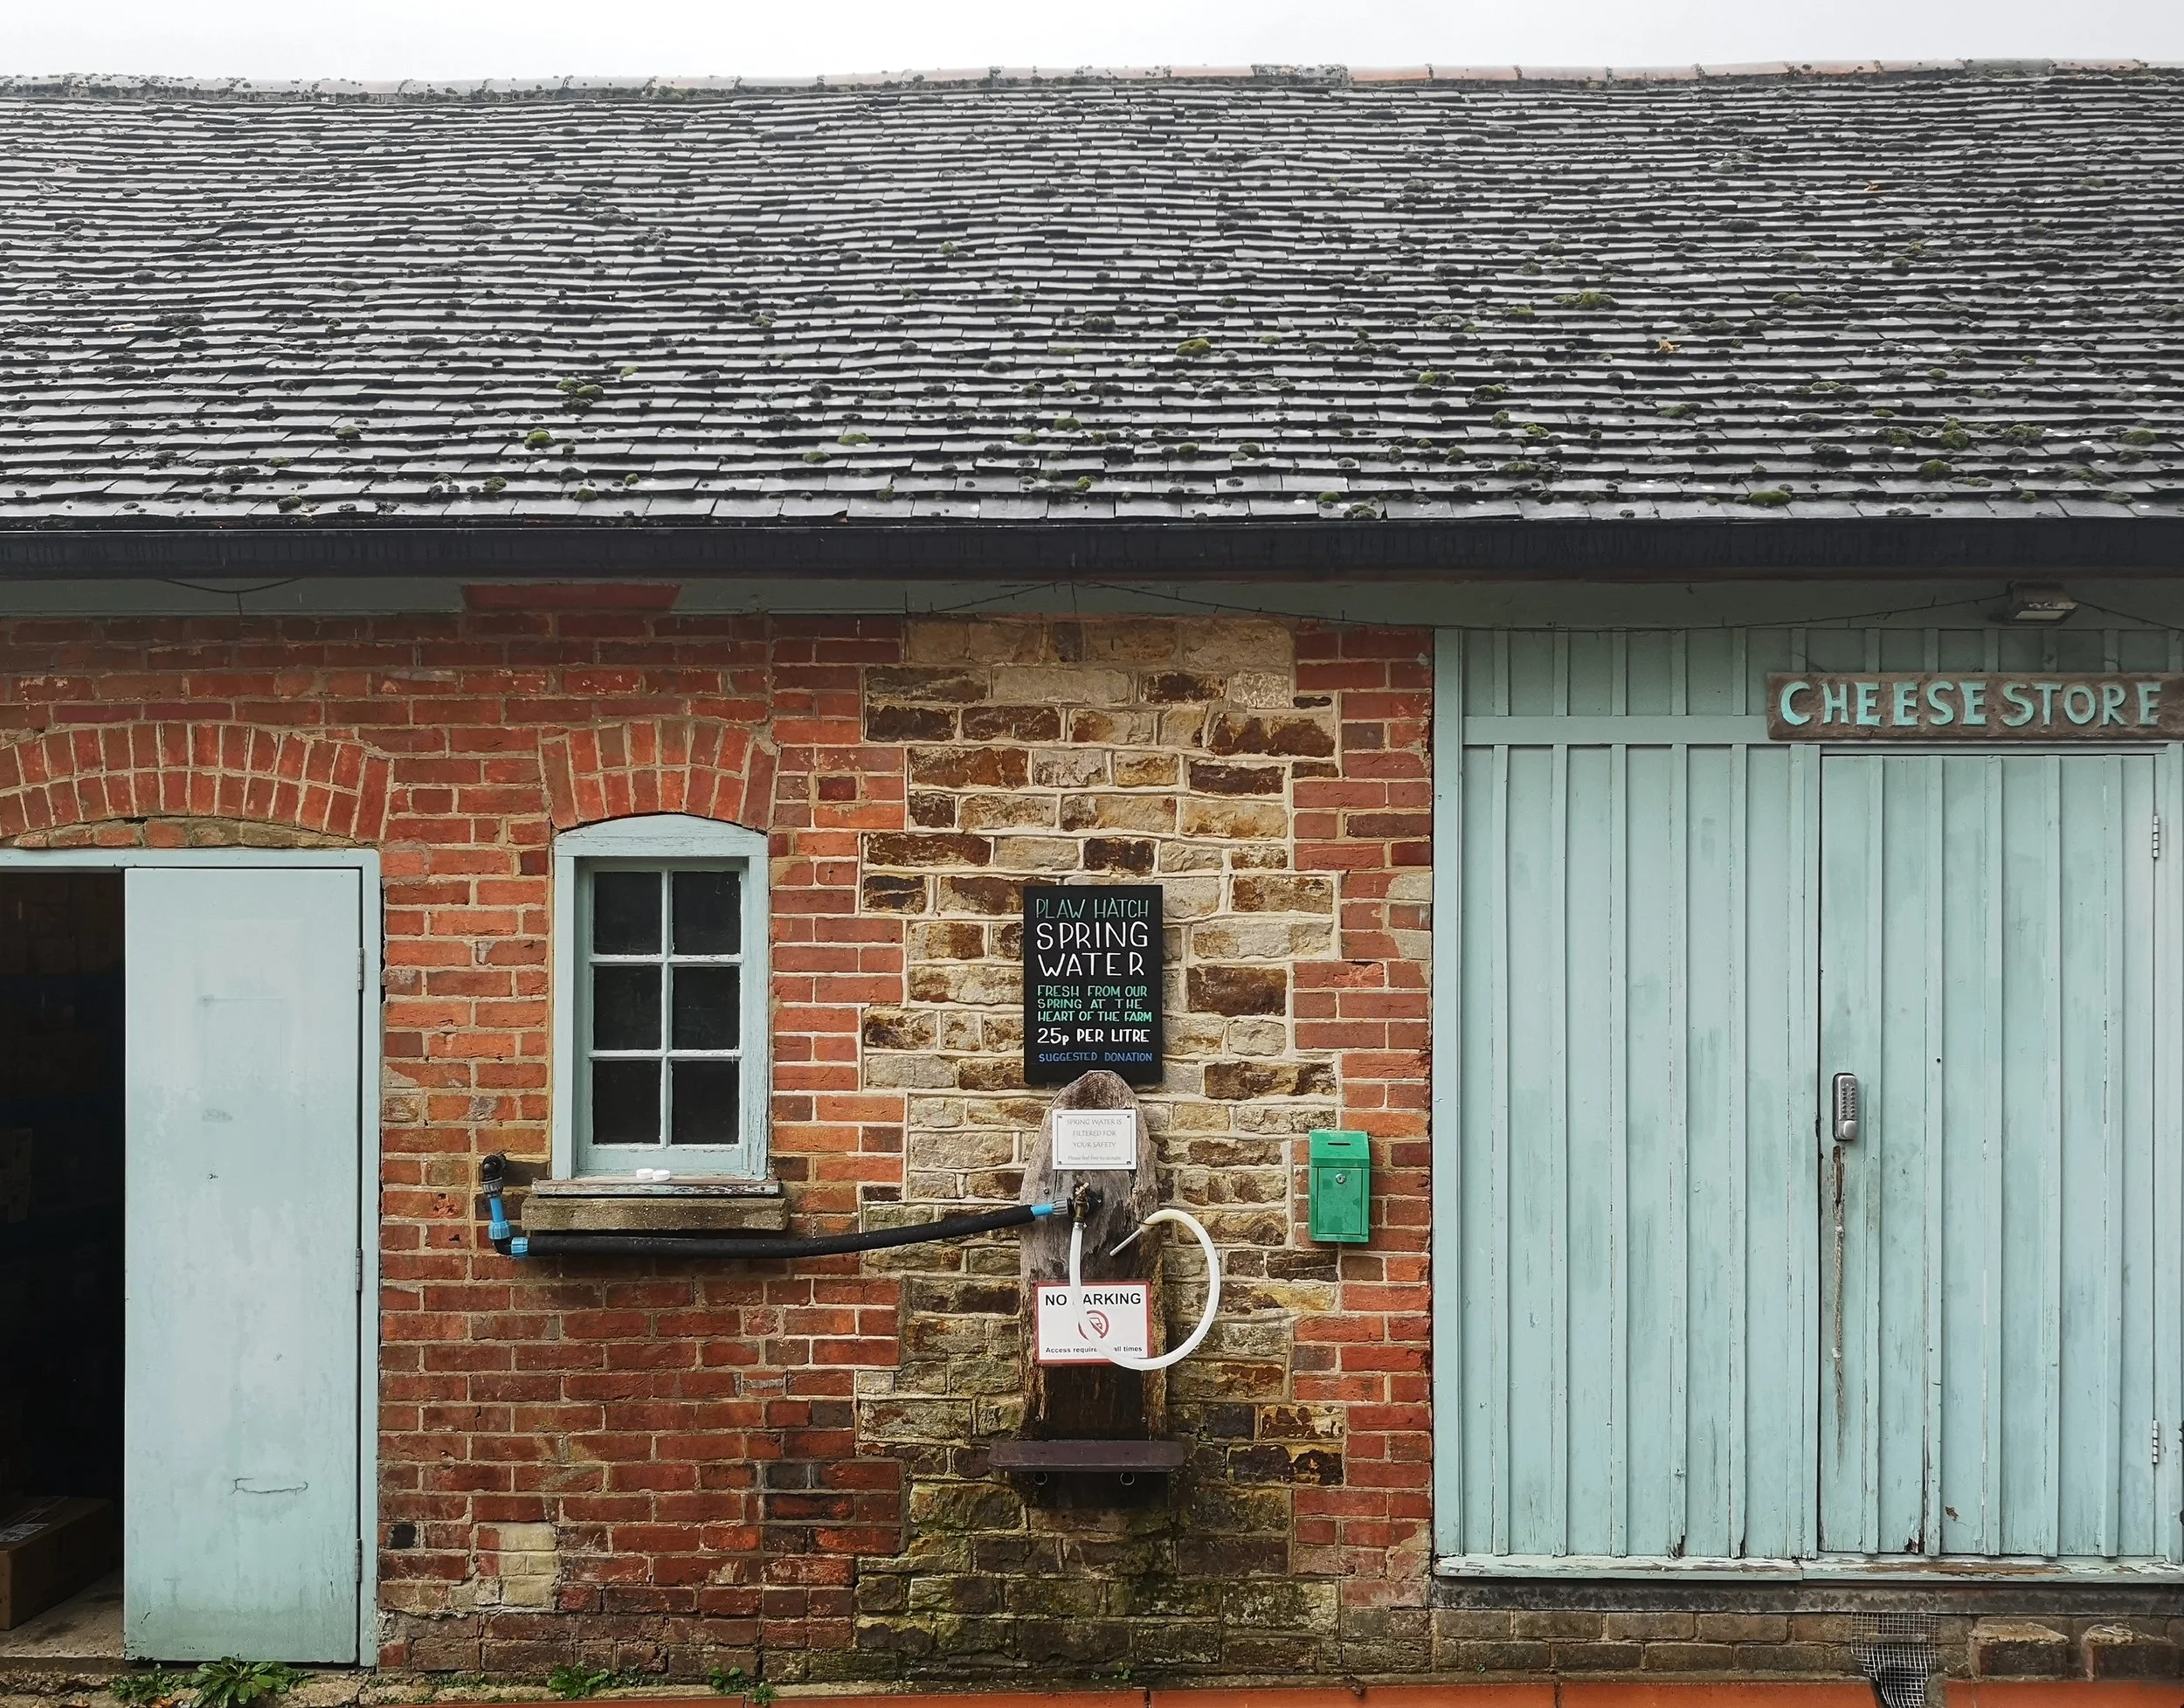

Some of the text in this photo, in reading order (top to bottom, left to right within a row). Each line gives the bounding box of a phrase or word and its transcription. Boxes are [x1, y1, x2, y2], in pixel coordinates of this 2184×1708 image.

[1779, 680, 2162, 727] CHEESE STORE
[1035, 898, 1149, 918] PLAW HATCH
[1036, 921, 1149, 951] SPRING
[1037, 951, 1145, 977] WATER
[1037, 985, 1148, 997] FRESH FROM OUR
[1038, 999, 1144, 1010] SPRING AT THE
[1038, 1011, 1152, 1022] HEART OF THE FARM
[1037, 1027, 1151, 1045] 25p PER LITRE
[1039, 1052, 1153, 1062] SUGGESTED DONATION
[1045, 1293, 1142, 1306] NO ARKING
